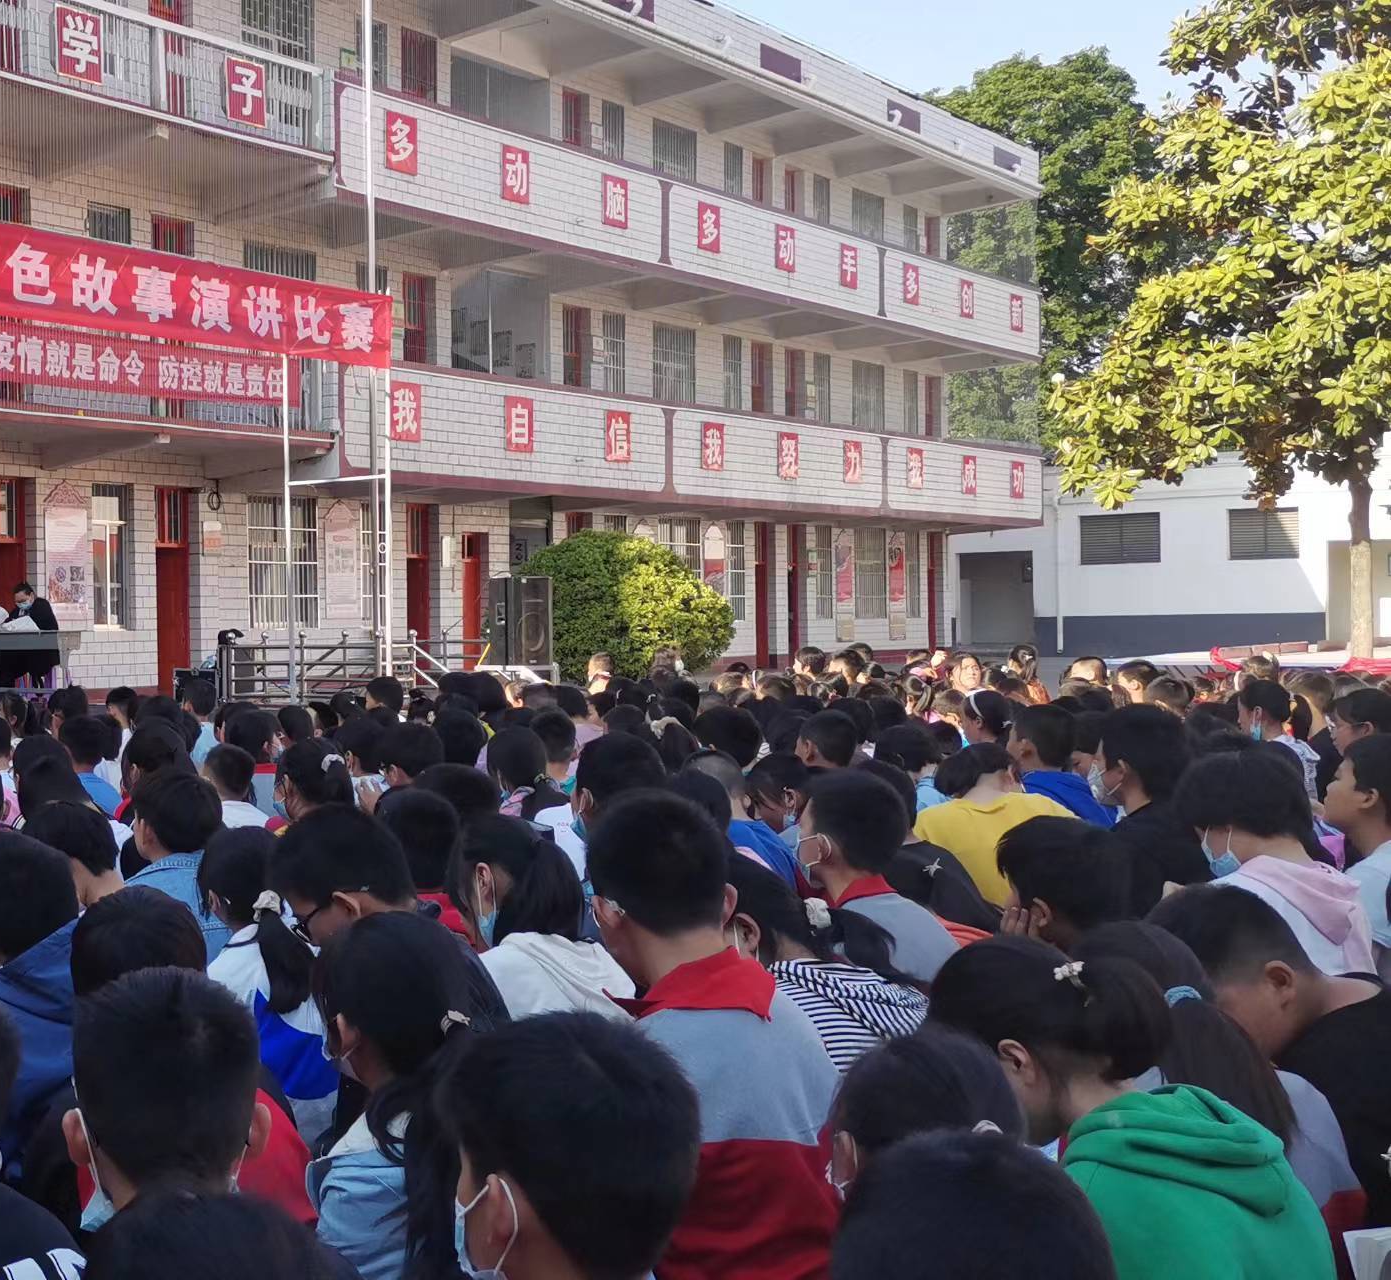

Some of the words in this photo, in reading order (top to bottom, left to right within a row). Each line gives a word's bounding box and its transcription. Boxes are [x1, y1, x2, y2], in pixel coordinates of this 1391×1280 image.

[159, 354, 284, 399] 防控就是责任
